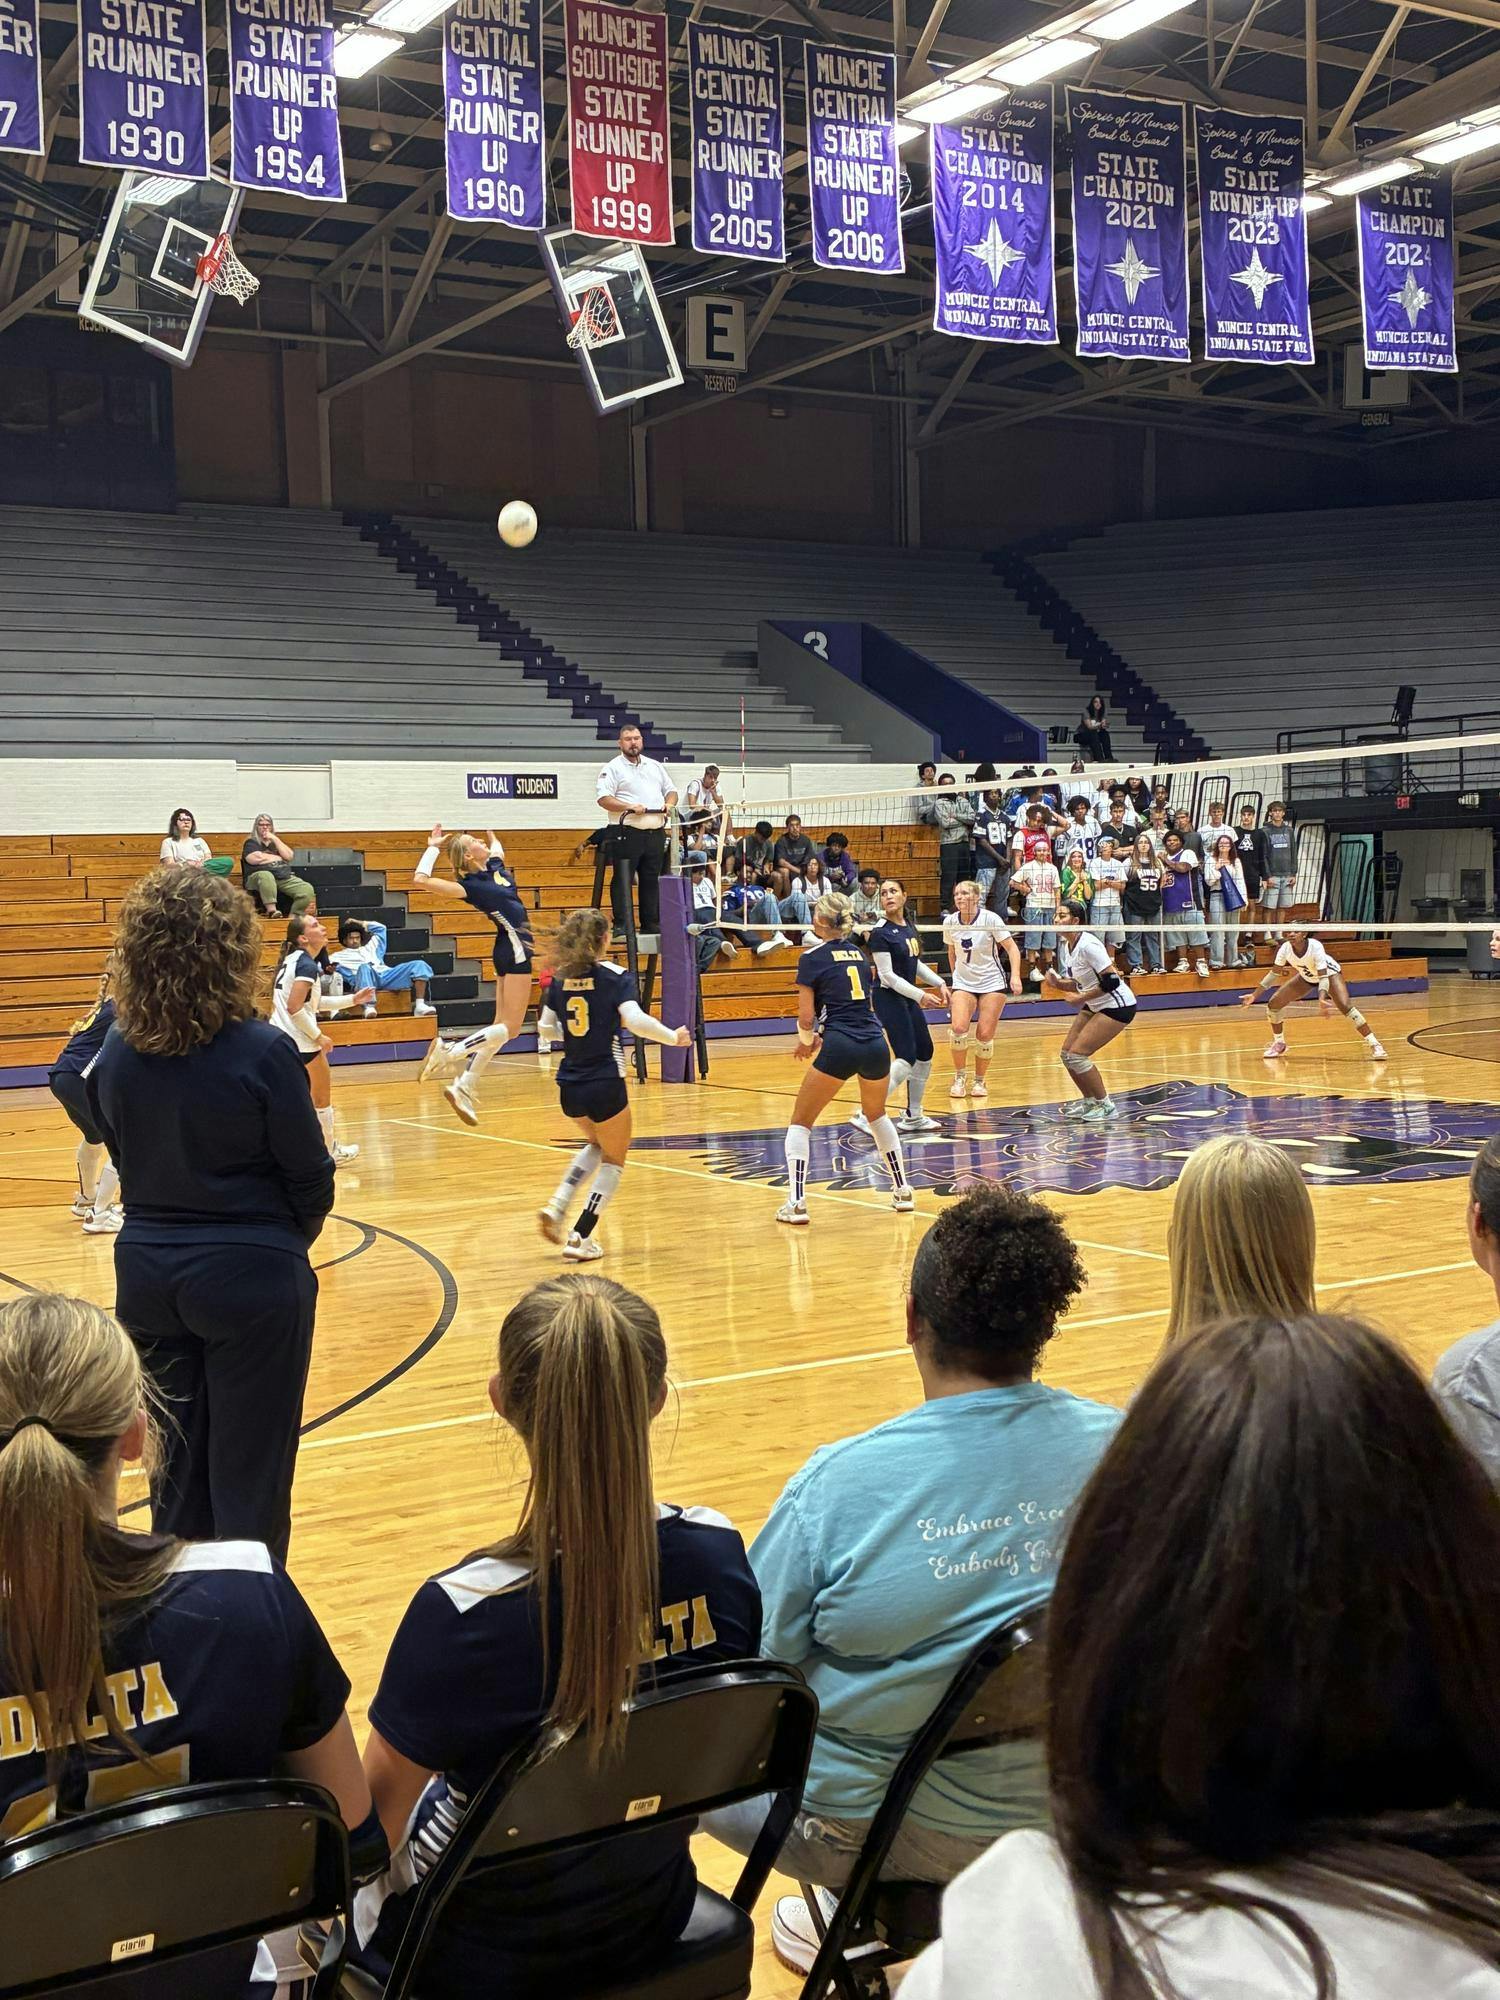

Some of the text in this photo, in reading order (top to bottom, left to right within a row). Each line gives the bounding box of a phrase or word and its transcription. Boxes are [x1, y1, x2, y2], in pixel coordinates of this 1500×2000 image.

[101, 0, 184, 45] STATE
[577, 9, 657, 53] MUNCIE
[87, 33, 202, 86] RUNNER
[249, 24, 322, 67] STATE
[450, 21, 536, 68] CENTRAL
[698, 33, 775, 74] MUNCIE
[234, 60, 337, 110] RUNNER
[460, 63, 524, 105] STATE
[572, 45, 663, 91] SOUTHSIDE
[816, 53, 886, 92] MUNCIE
[127, 81, 165, 120] UP
[584, 85, 652, 126] STATE
[695, 68, 777, 110] CENTRAL
[448, 98, 540, 144] RUNNER
[812, 87, 892, 127] CENTRAL
[997, 110, 1037, 129] Guard
[1072, 102, 1114, 124] Spirit
[1115, 111, 1131, 127] of
[272, 105, 303, 145] UP
[575, 119, 664, 165] RUNNER
[706, 106, 770, 144] STATE
[961, 126, 1025, 156] STATE
[1088, 123, 1170, 148] Band & Guard
[1240, 128, 1253, 147] of
[1255, 128, 1302, 146] Muncie
[107, 120, 185, 166] 1930
[481, 140, 508, 174] UP
[698, 139, 783, 180] RUNNER
[823, 124, 884, 161] STATE
[1210, 144, 1294, 167] Band & Guard
[254, 144, 326, 189] 1954
[606, 160, 636, 194] UP
[814, 156, 894, 197] RUNNER
[945, 150, 1043, 185] CHAMPION
[1097, 152, 1159, 180] STATE
[1224, 166, 1280, 192] STATE
[464, 177, 525, 217] 1960
[728, 178, 754, 212] UP
[963, 181, 1025, 213] 2014
[1083, 175, 1175, 208] CHAMPION
[1209, 190, 1299, 218] RUNNER-UP
[1380, 184, 1432, 208] STATE
[591, 195, 652, 234] 1999
[842, 193, 869, 226] UP
[1105, 201, 1157, 230] 2021
[710, 213, 773, 250] 2005
[828, 228, 885, 264] 2006
[1228, 217, 1281, 245] 2023
[1385, 242, 1432, 267] 2024
[945, 292, 1045, 314] MUNCIE CENTRAL
[705, 303, 735, 361] E
[944, 309, 1051, 332] INDIANA STATE FAIR
[1129, 315, 1177, 333] CENTRAL
[1217, 320, 1302, 337] MUNCIE CENTRAL
[1375, 331, 1409, 343] MUNCIE
[1122, 333, 1158, 347] STATE
[1160, 335, 1188, 349] FAIR
[1210, 337, 1250, 351] INDIANA
[1252, 339, 1282, 352] STATE
[1367, 350, 1406, 363] INDIANA
[705, 374, 736, 393] RESERVED
[472, 776, 554, 795] CENTRAL STUDENTS
[1140, 878, 1158, 891] 55
[905, 937, 919, 957] 10
[963, 949, 972, 963] 7
[846, 965, 866, 1000] 1
[566, 996, 590, 1037] 3
[917, 1513, 1014, 1541] Embrace
[928, 1546, 1020, 1580] Embody
